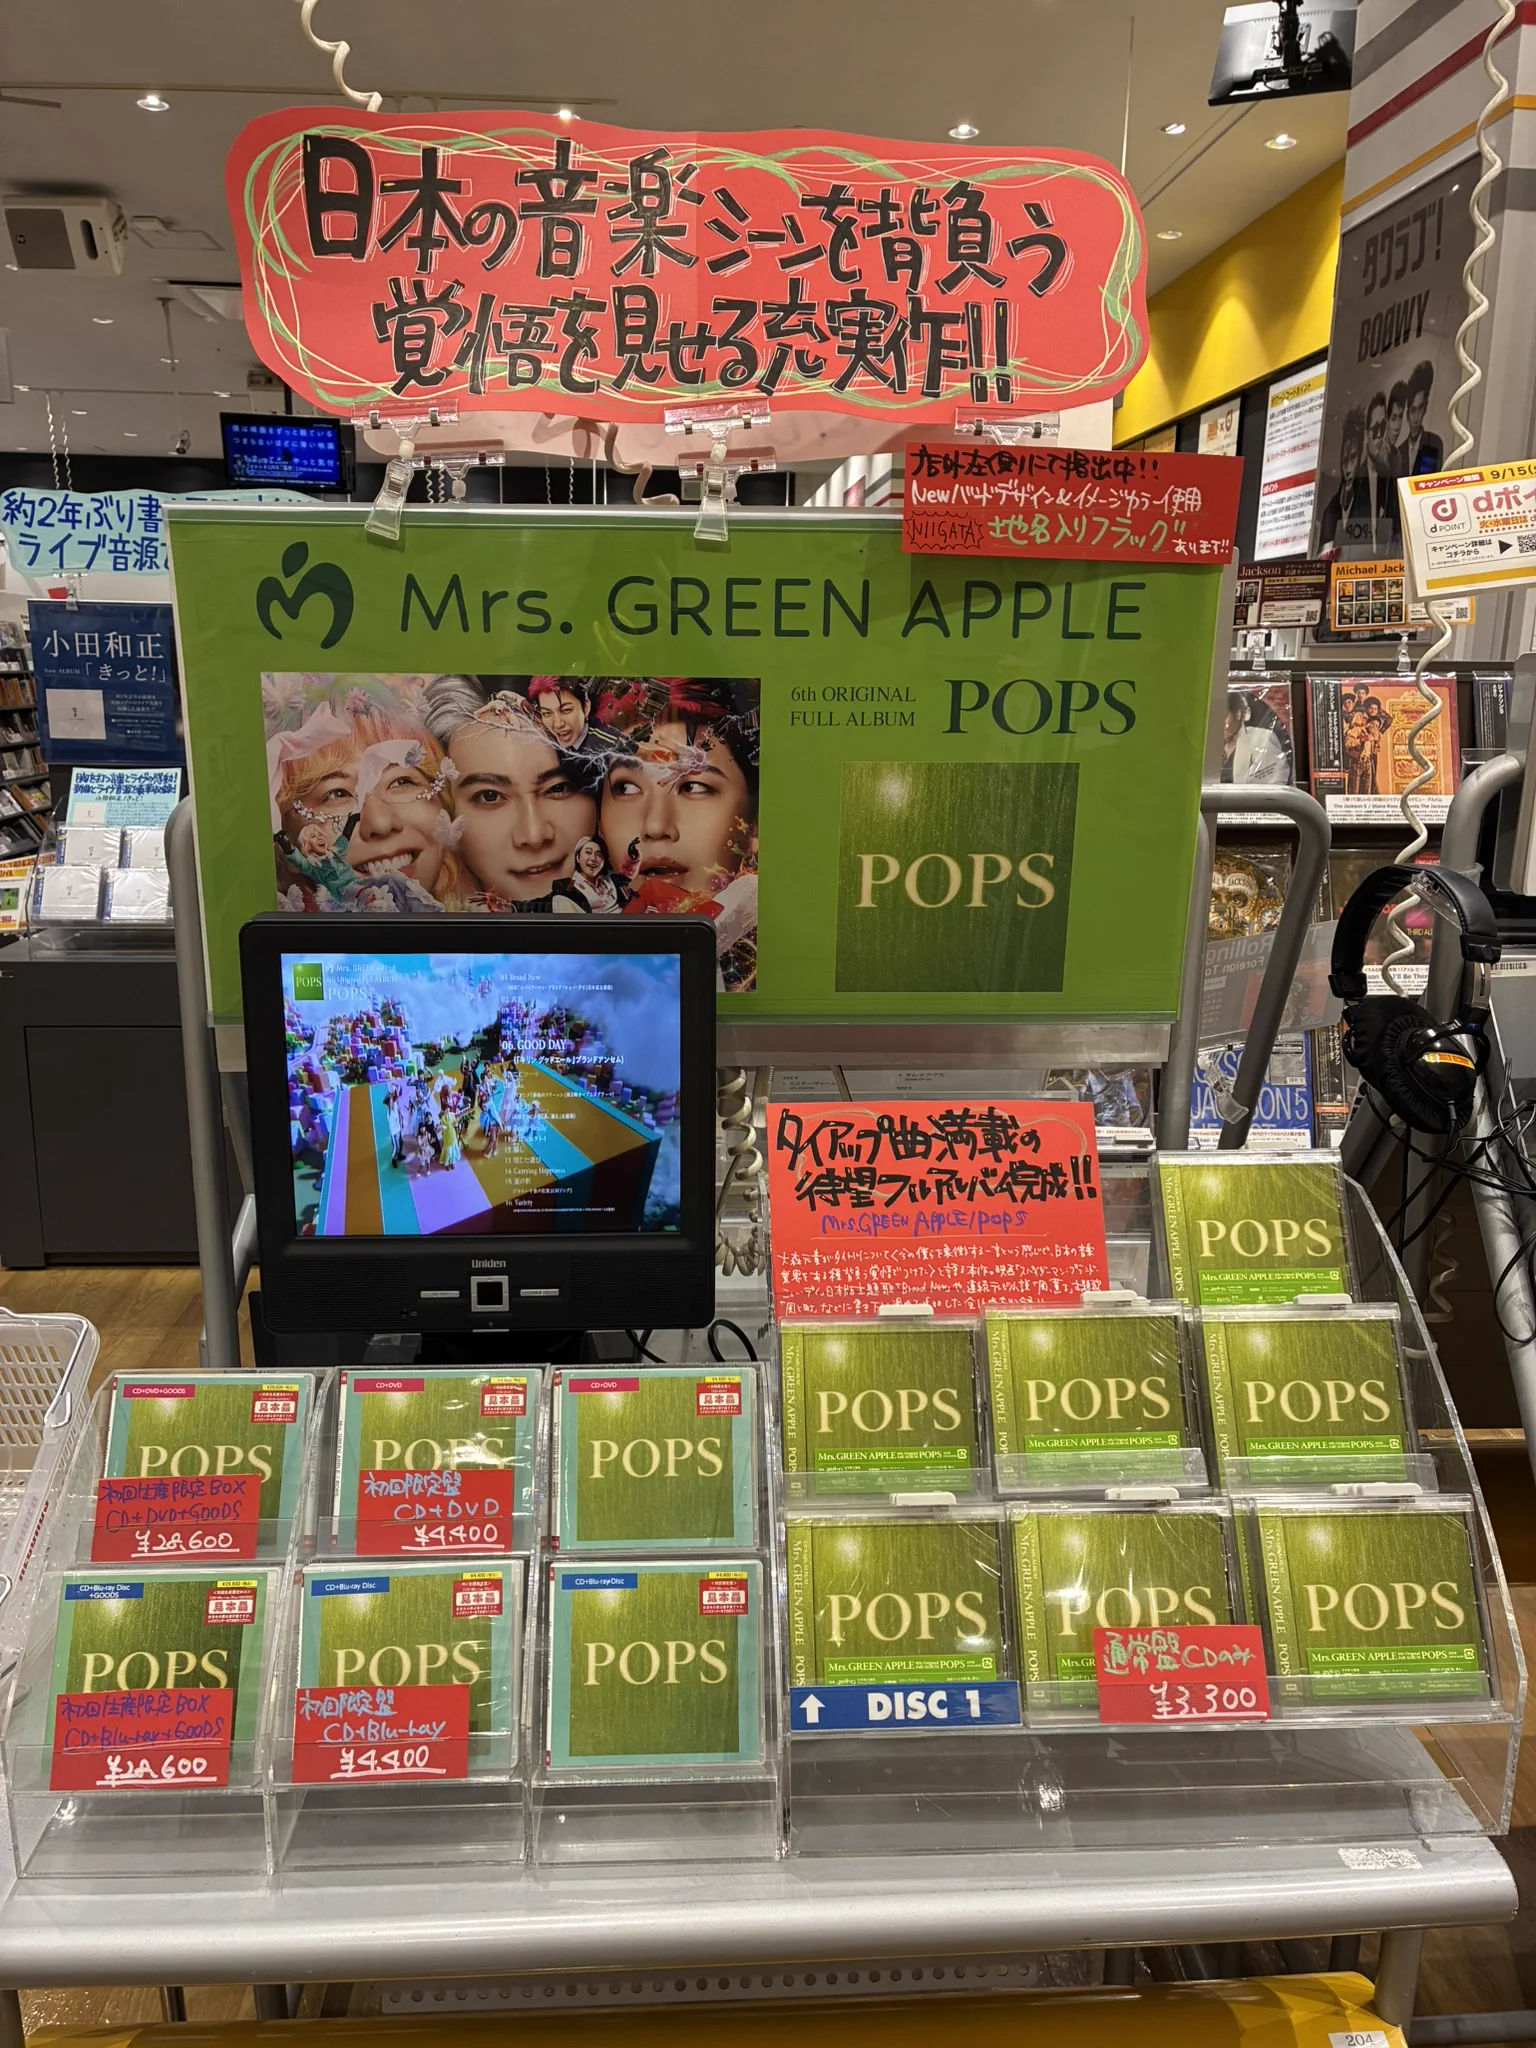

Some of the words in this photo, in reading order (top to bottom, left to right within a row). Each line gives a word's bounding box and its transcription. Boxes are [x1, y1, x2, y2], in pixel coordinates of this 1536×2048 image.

[303, 133, 1068, 296] 日本の音楽シーンを背負う
[371, 275, 1013, 403] 覚悟を見せる充実作!!
[912, 520, 977, 545] NIIGATA
[987, 512, 1188, 552] 地名入りフラッグ
[1171, 538, 1231, 557] あります!!
[1439, 522, 1466, 532] POINT
[1446, 549, 1480, 559] コチラから
[1239, 565, 1282, 577] Jackson
[1335, 565, 1378, 576] Michael
[400, 573, 573, 634] Mrs.
[607, 575, 870, 638] GREEN
[900, 578, 1146, 641] APPLE
[42, 631, 165, 660] 小田和正
[790, 685, 817, 703] 6th
[821, 685, 917, 703] ORIGINAL
[942, 678, 1137, 736] POPS
[789, 710, 841, 728] FULL
[845, 710, 916, 728] ALBUM
[854, 852, 1056, 909] POPS
[1406, 928, 1424, 936] THIRD
[295, 977, 322, 988] POPS
[328, 987, 367, 1000] POPS
[517, 1039, 546, 1051] GOOD
[548, 1039, 567, 1051] DAY
[776, 1105, 1041, 1171] タイアップ曲満載の
[795, 1154, 1098, 1212] 待望フルアルバム完成!!
[515, 1199, 533, 1207] Variety
[1196, 1218, 1333, 1258] POPS
[471, 1259, 507, 1269] Uniden
[1201, 1271, 1248, 1282] Mrs.GREEN
[1249, 1272, 1275, 1281] APPLE
[1295, 1271, 1317, 1280] POPS
[1174, 1265, 1185, 1292] POPS
[132, 1387, 186, 1395] CD+DVD+GOODS
[375, 1381, 403, 1389] CD+DVD
[590, 1381, 618, 1389] CD+DVD
[815, 1387, 962, 1433] POPS
[1023, 1376, 1171, 1422] POPS
[1242, 1379, 1391, 1423] POPS
[787, 1407, 797, 1439] APPLE
[818, 1451, 868, 1461] Mrs.GREEN
[868, 1451, 897, 1461] APPLE
[919, 1450, 943, 1459] POPS
[1028, 1438, 1078, 1448] Mrs.GREEN
[1079, 1437, 1108, 1447] APPLE
[1129, 1436, 1154, 1446] POPS
[1249, 1441, 1300, 1451] Mrs.GREEN
[1300, 1441, 1329, 1450] APPLE
[1350, 1440, 1375, 1449] POPS
[139, 1444, 273, 1484] POPS
[589, 1436, 724, 1479] POPS
[106, 1500, 243, 1533] CD+DVD+GOODS
[393, 1498, 500, 1521] CD+DVD
[79, 1584, 114, 1593] CD+Blu-ray
[325, 1582, 361, 1592] CD+Blu-ray
[362, 1581, 376, 1590] Disc
[574, 1577, 610, 1587] CD+Blu-ray
[610, 1577, 625, 1586] Disc
[213, 1600, 249, 1613] 見本品
[459, 1592, 496, 1604] 見本品
[706, 1591, 741, 1603] 見本品
[1303, 1580, 1466, 1633] POPS
[826, 1590, 988, 1643] POPS
[1022, 1602, 1037, 1641] APPLE
[1058, 1586, 1218, 1636] POPS
[1272, 1592, 1287, 1635] APPLE
[794, 1607, 805, 1646] APPLE
[335, 1642, 481, 1687] POPS
[583, 1639, 729, 1686] POPS
[828, 1661, 883, 1672] Mrs.GREEN
[884, 1660, 916, 1671] APPLE
[940, 1659, 966, 1669] POPS
[1028, 1649, 1040, 1682] POPS
[1278, 1643, 1291, 1677] POPS
[1312, 1652, 1366, 1663] Mrs.GREEN
[1367, 1651, 1398, 1661] APPLE
[1421, 1650, 1448, 1660] POPS
[82, 1650, 229, 1693] POPS
[795, 1655, 806, 1687] POPS
[867, 1690, 949, 1721] DISC
[965, 1689, 981, 1718] 1
[1345, 2033, 1374, 2047] 204
